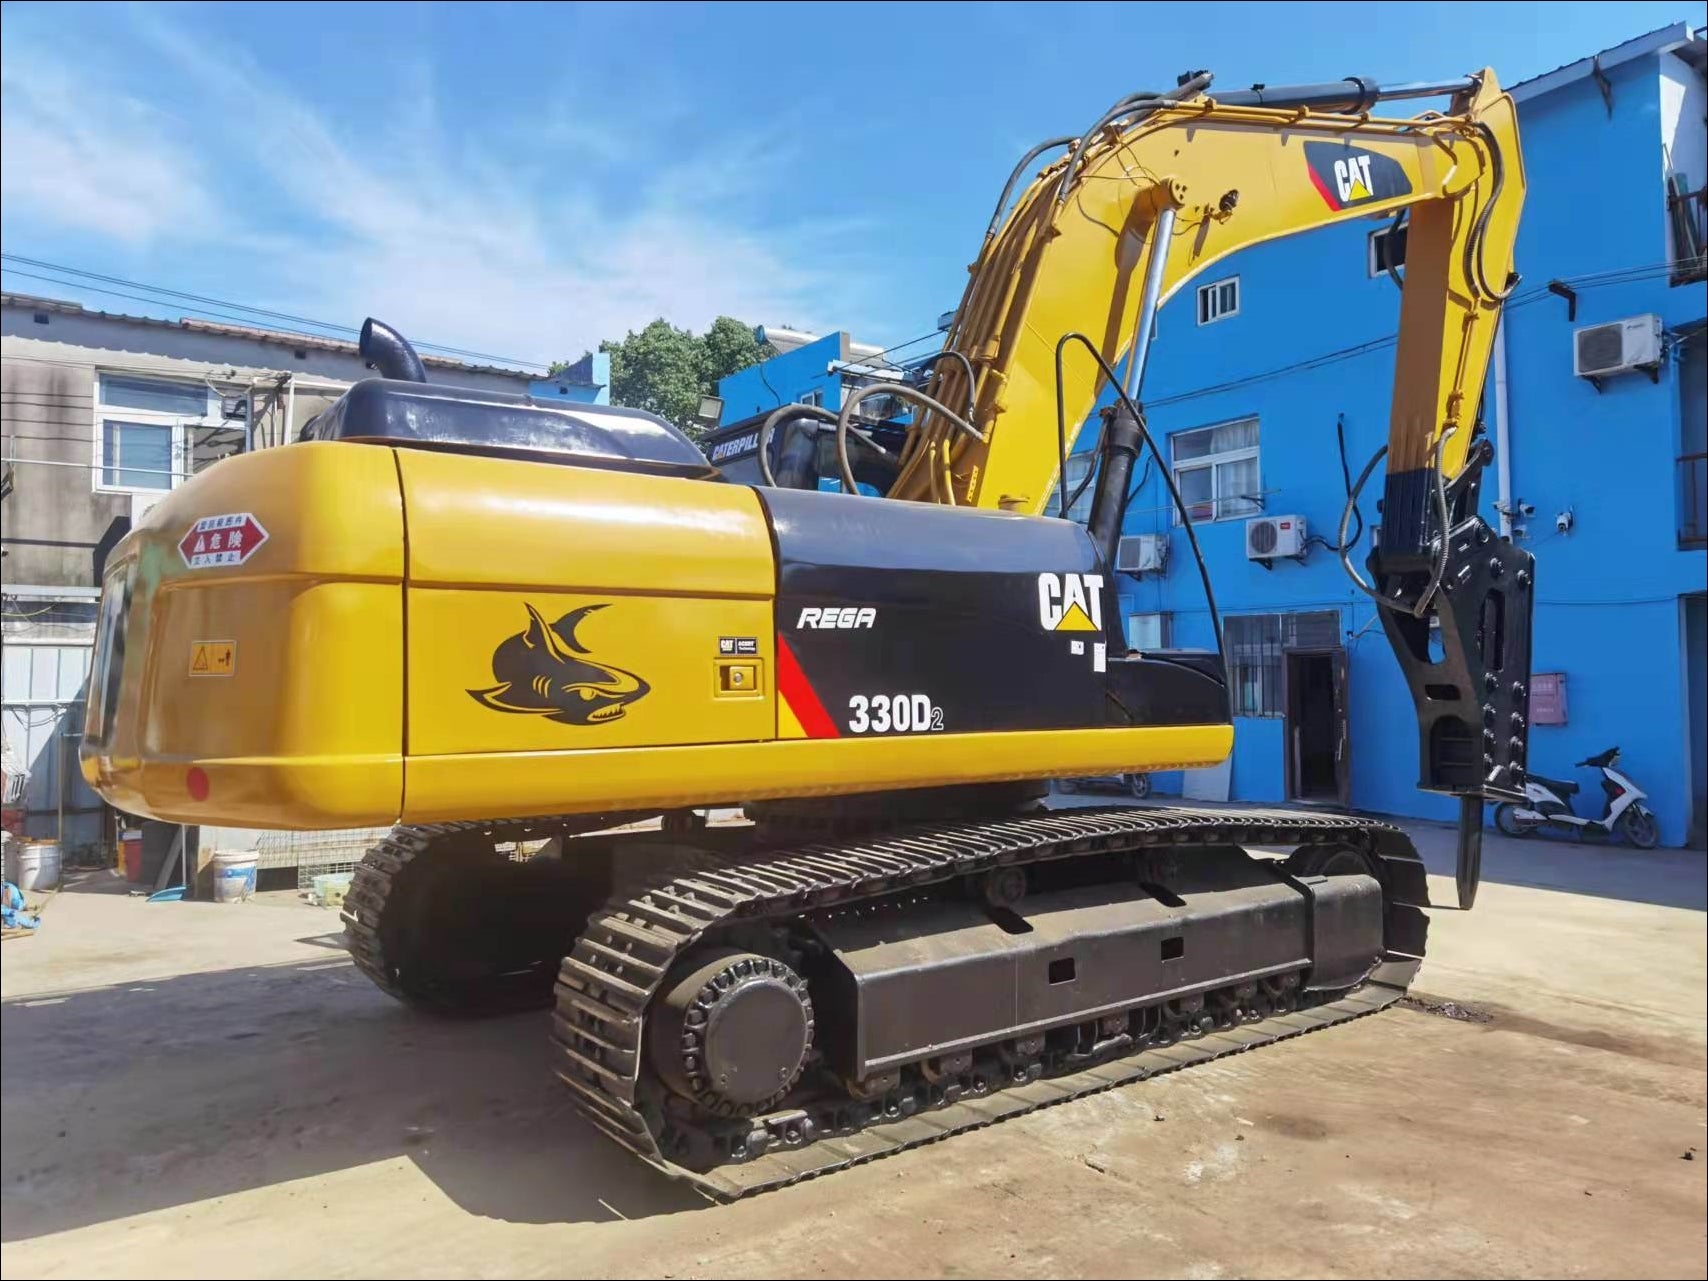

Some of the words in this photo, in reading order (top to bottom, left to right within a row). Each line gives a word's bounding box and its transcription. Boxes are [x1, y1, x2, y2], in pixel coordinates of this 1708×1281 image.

[1334, 155, 1373, 202] CAT
[712, 427, 776, 461] CATERPILLR
[796, 607, 877, 629] REGA
[1038, 572, 1104, 632] CAT
[720, 639, 734, 649] CAT
